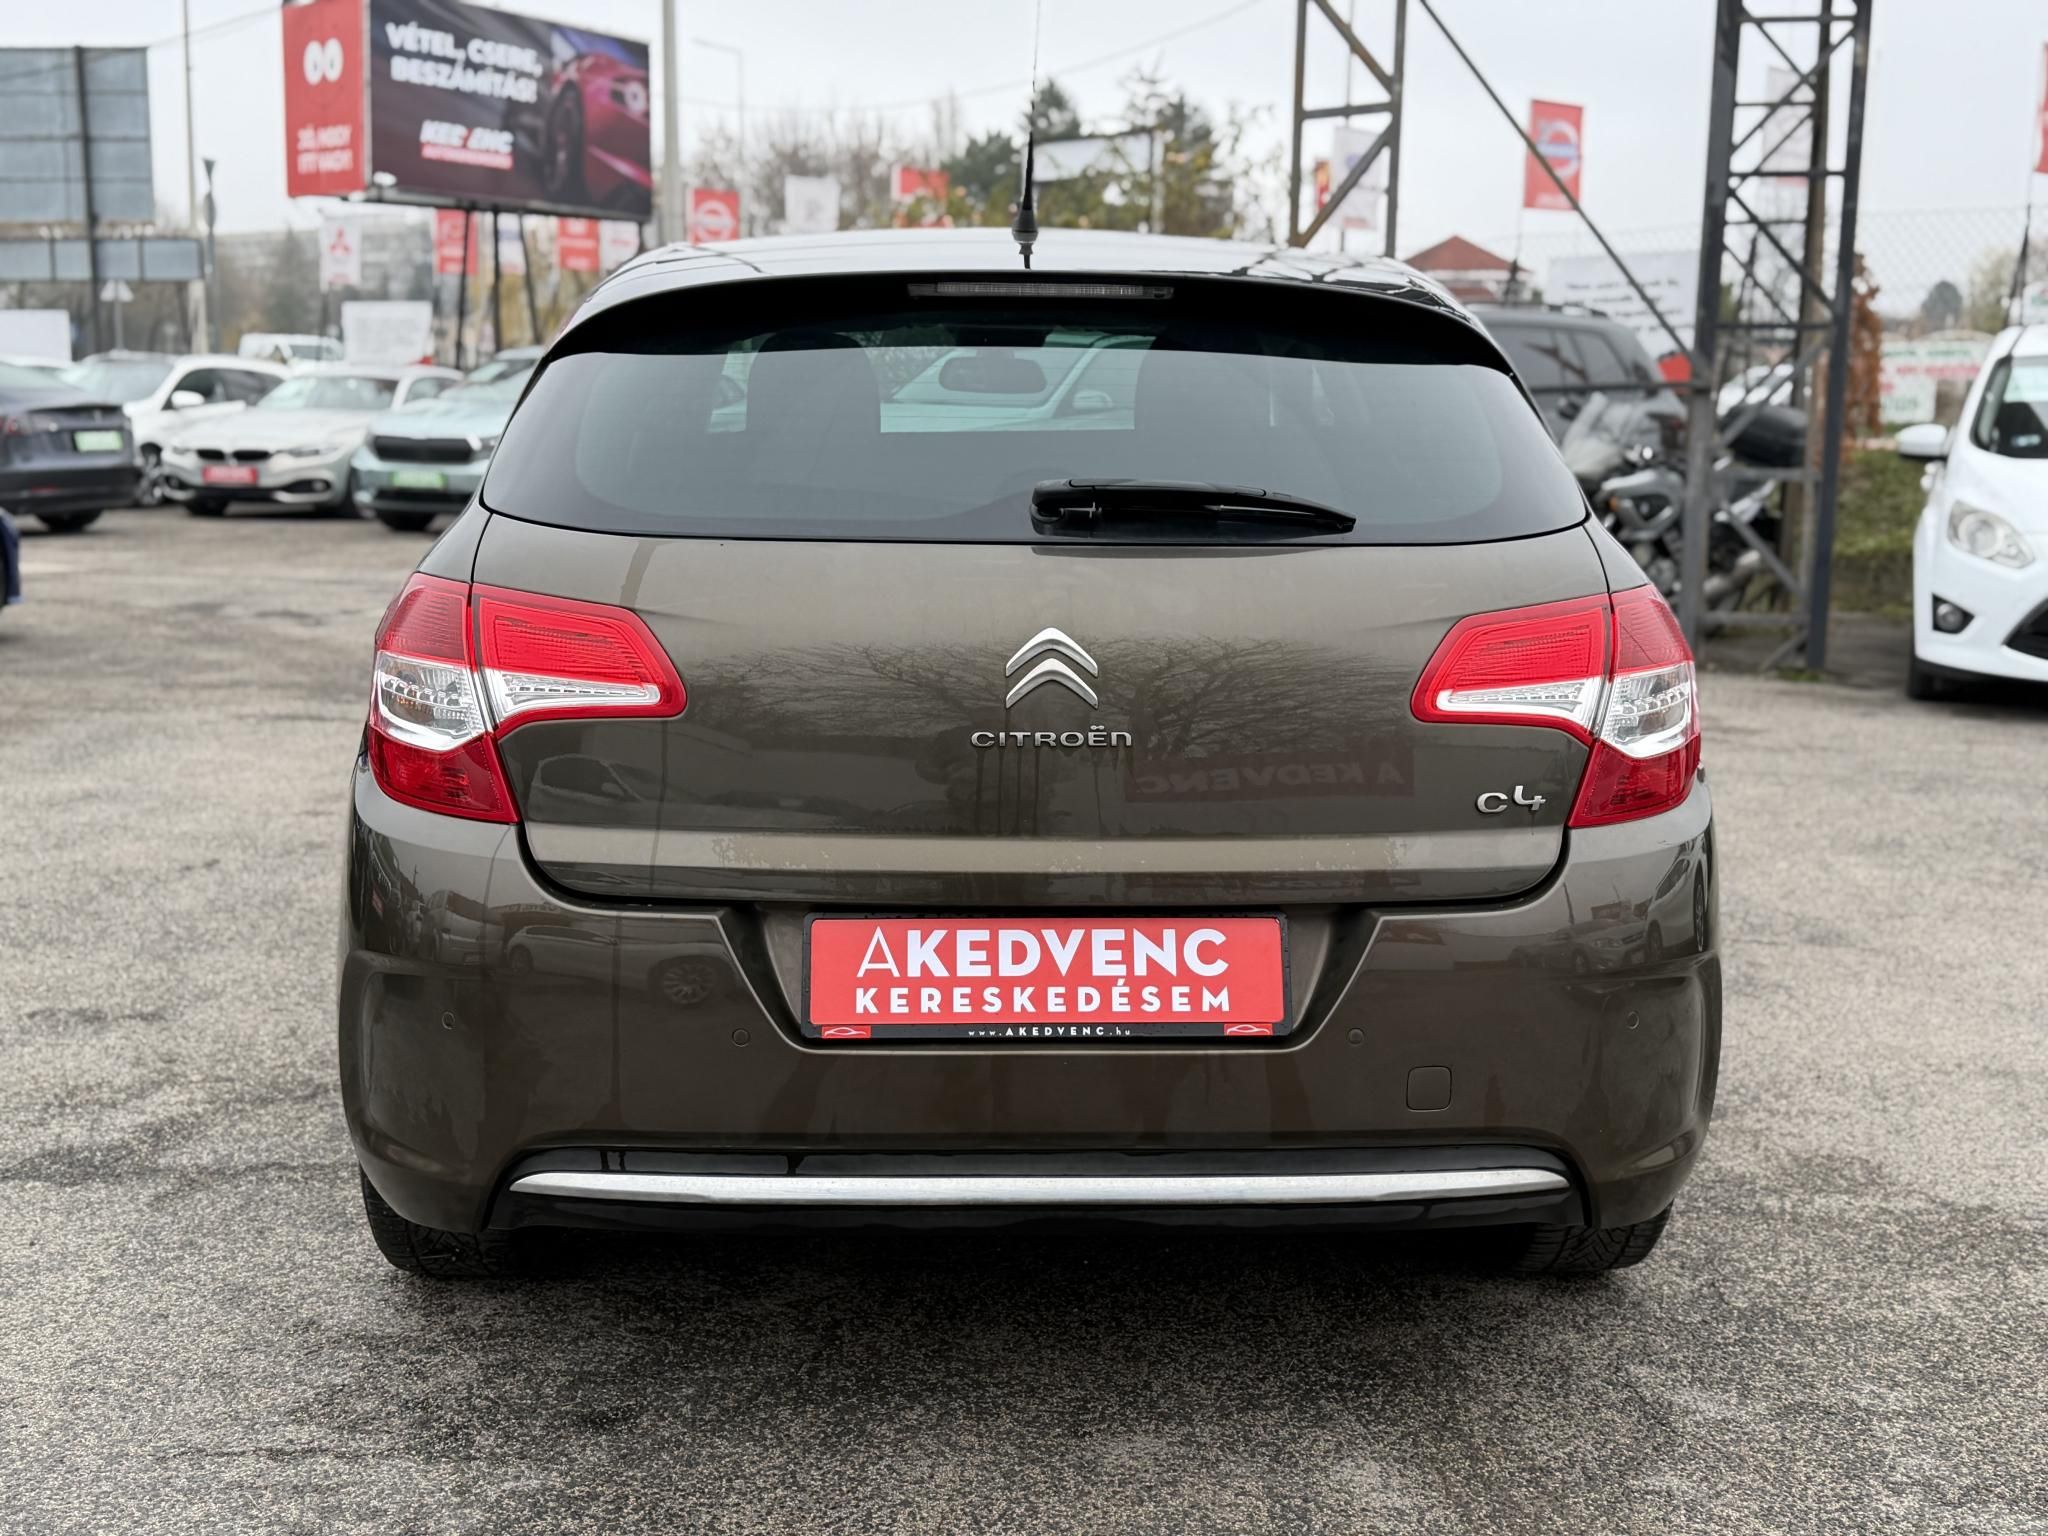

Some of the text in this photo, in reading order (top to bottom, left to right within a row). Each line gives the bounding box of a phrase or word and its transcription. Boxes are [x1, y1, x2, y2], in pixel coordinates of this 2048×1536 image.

[971, 725, 1132, 747] CITROËN
[1476, 785, 1547, 813] C4
[856, 926, 1229, 978] AKEDVENC
[855, 979, 1230, 1014] KERESKEDÉSEM
[968, 1026, 1131, 1037] www.AKEDVENC.hu
